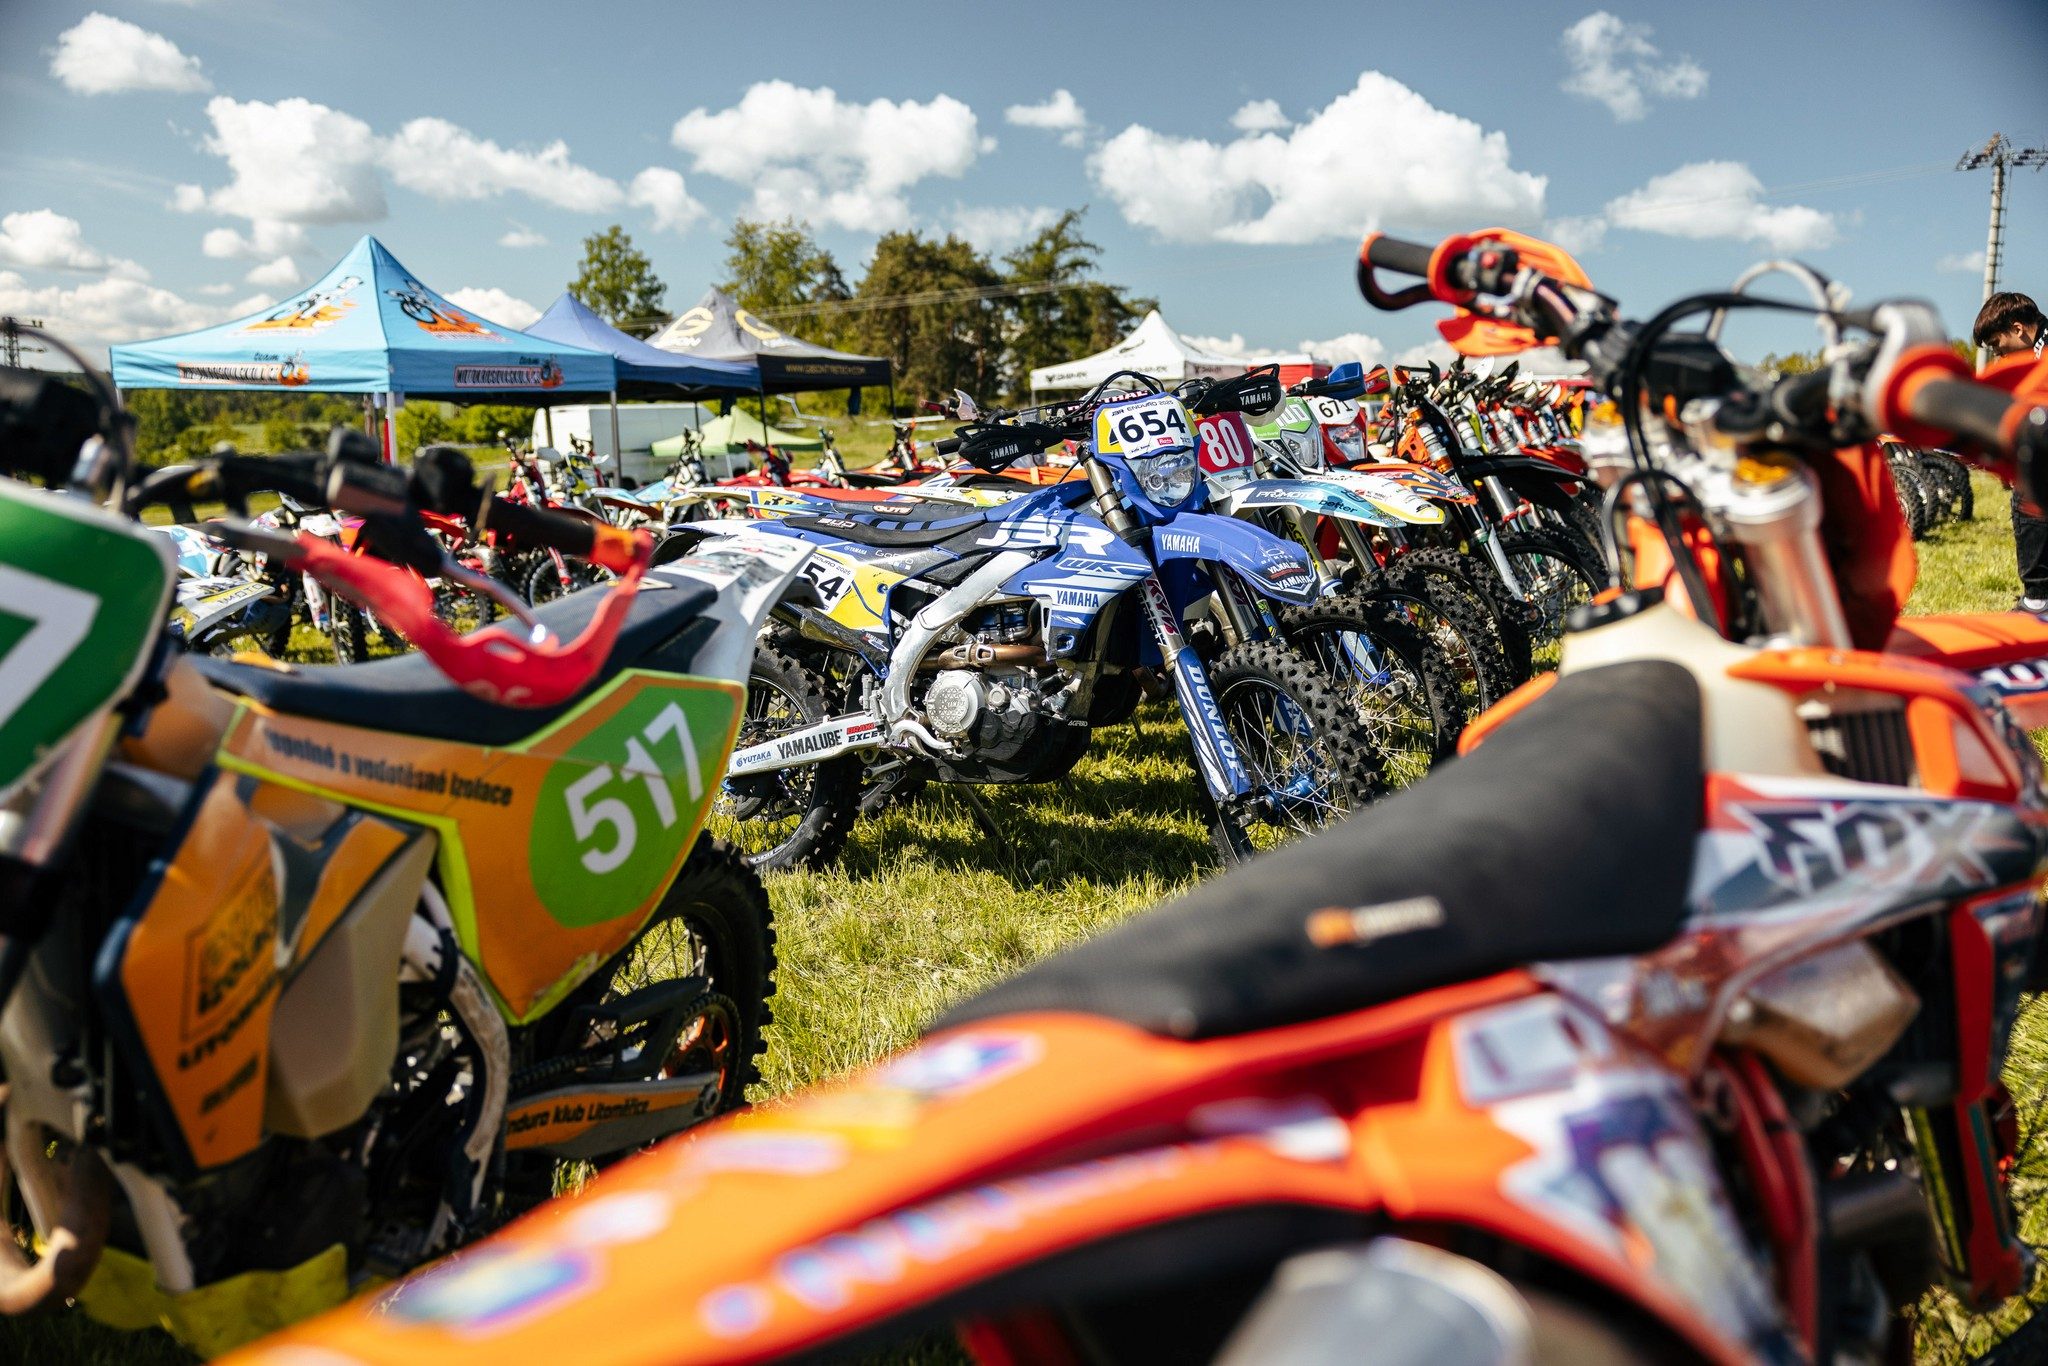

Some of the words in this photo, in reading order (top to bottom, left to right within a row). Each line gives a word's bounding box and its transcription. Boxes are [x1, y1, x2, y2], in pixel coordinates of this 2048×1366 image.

[1127, 401, 1158, 411] ENDURO
[1240, 391, 1272, 406] YAMAHA
[1318, 399, 1353, 418] 671
[1118, 408, 1187, 443] 654
[990, 443, 1020, 460] YAMAHA
[1199, 418, 1245, 467] 80
[1161, 533, 1201, 553] YAMAHA
[811, 554, 836, 569] NDURO
[803, 562, 845, 601] 54
[1276, 575, 1313, 590] YAMAHA
[1057, 590, 1100, 608] YAMAHA
[1186, 664, 1245, 779] DUNLOP
[742, 750, 772, 765] YUTAKA
[777, 731, 841, 760] YAMALUBE
[564, 701, 703, 875] 517
[508, 1110, 549, 1133] nduro
[553, 1103, 584, 1123] klub
